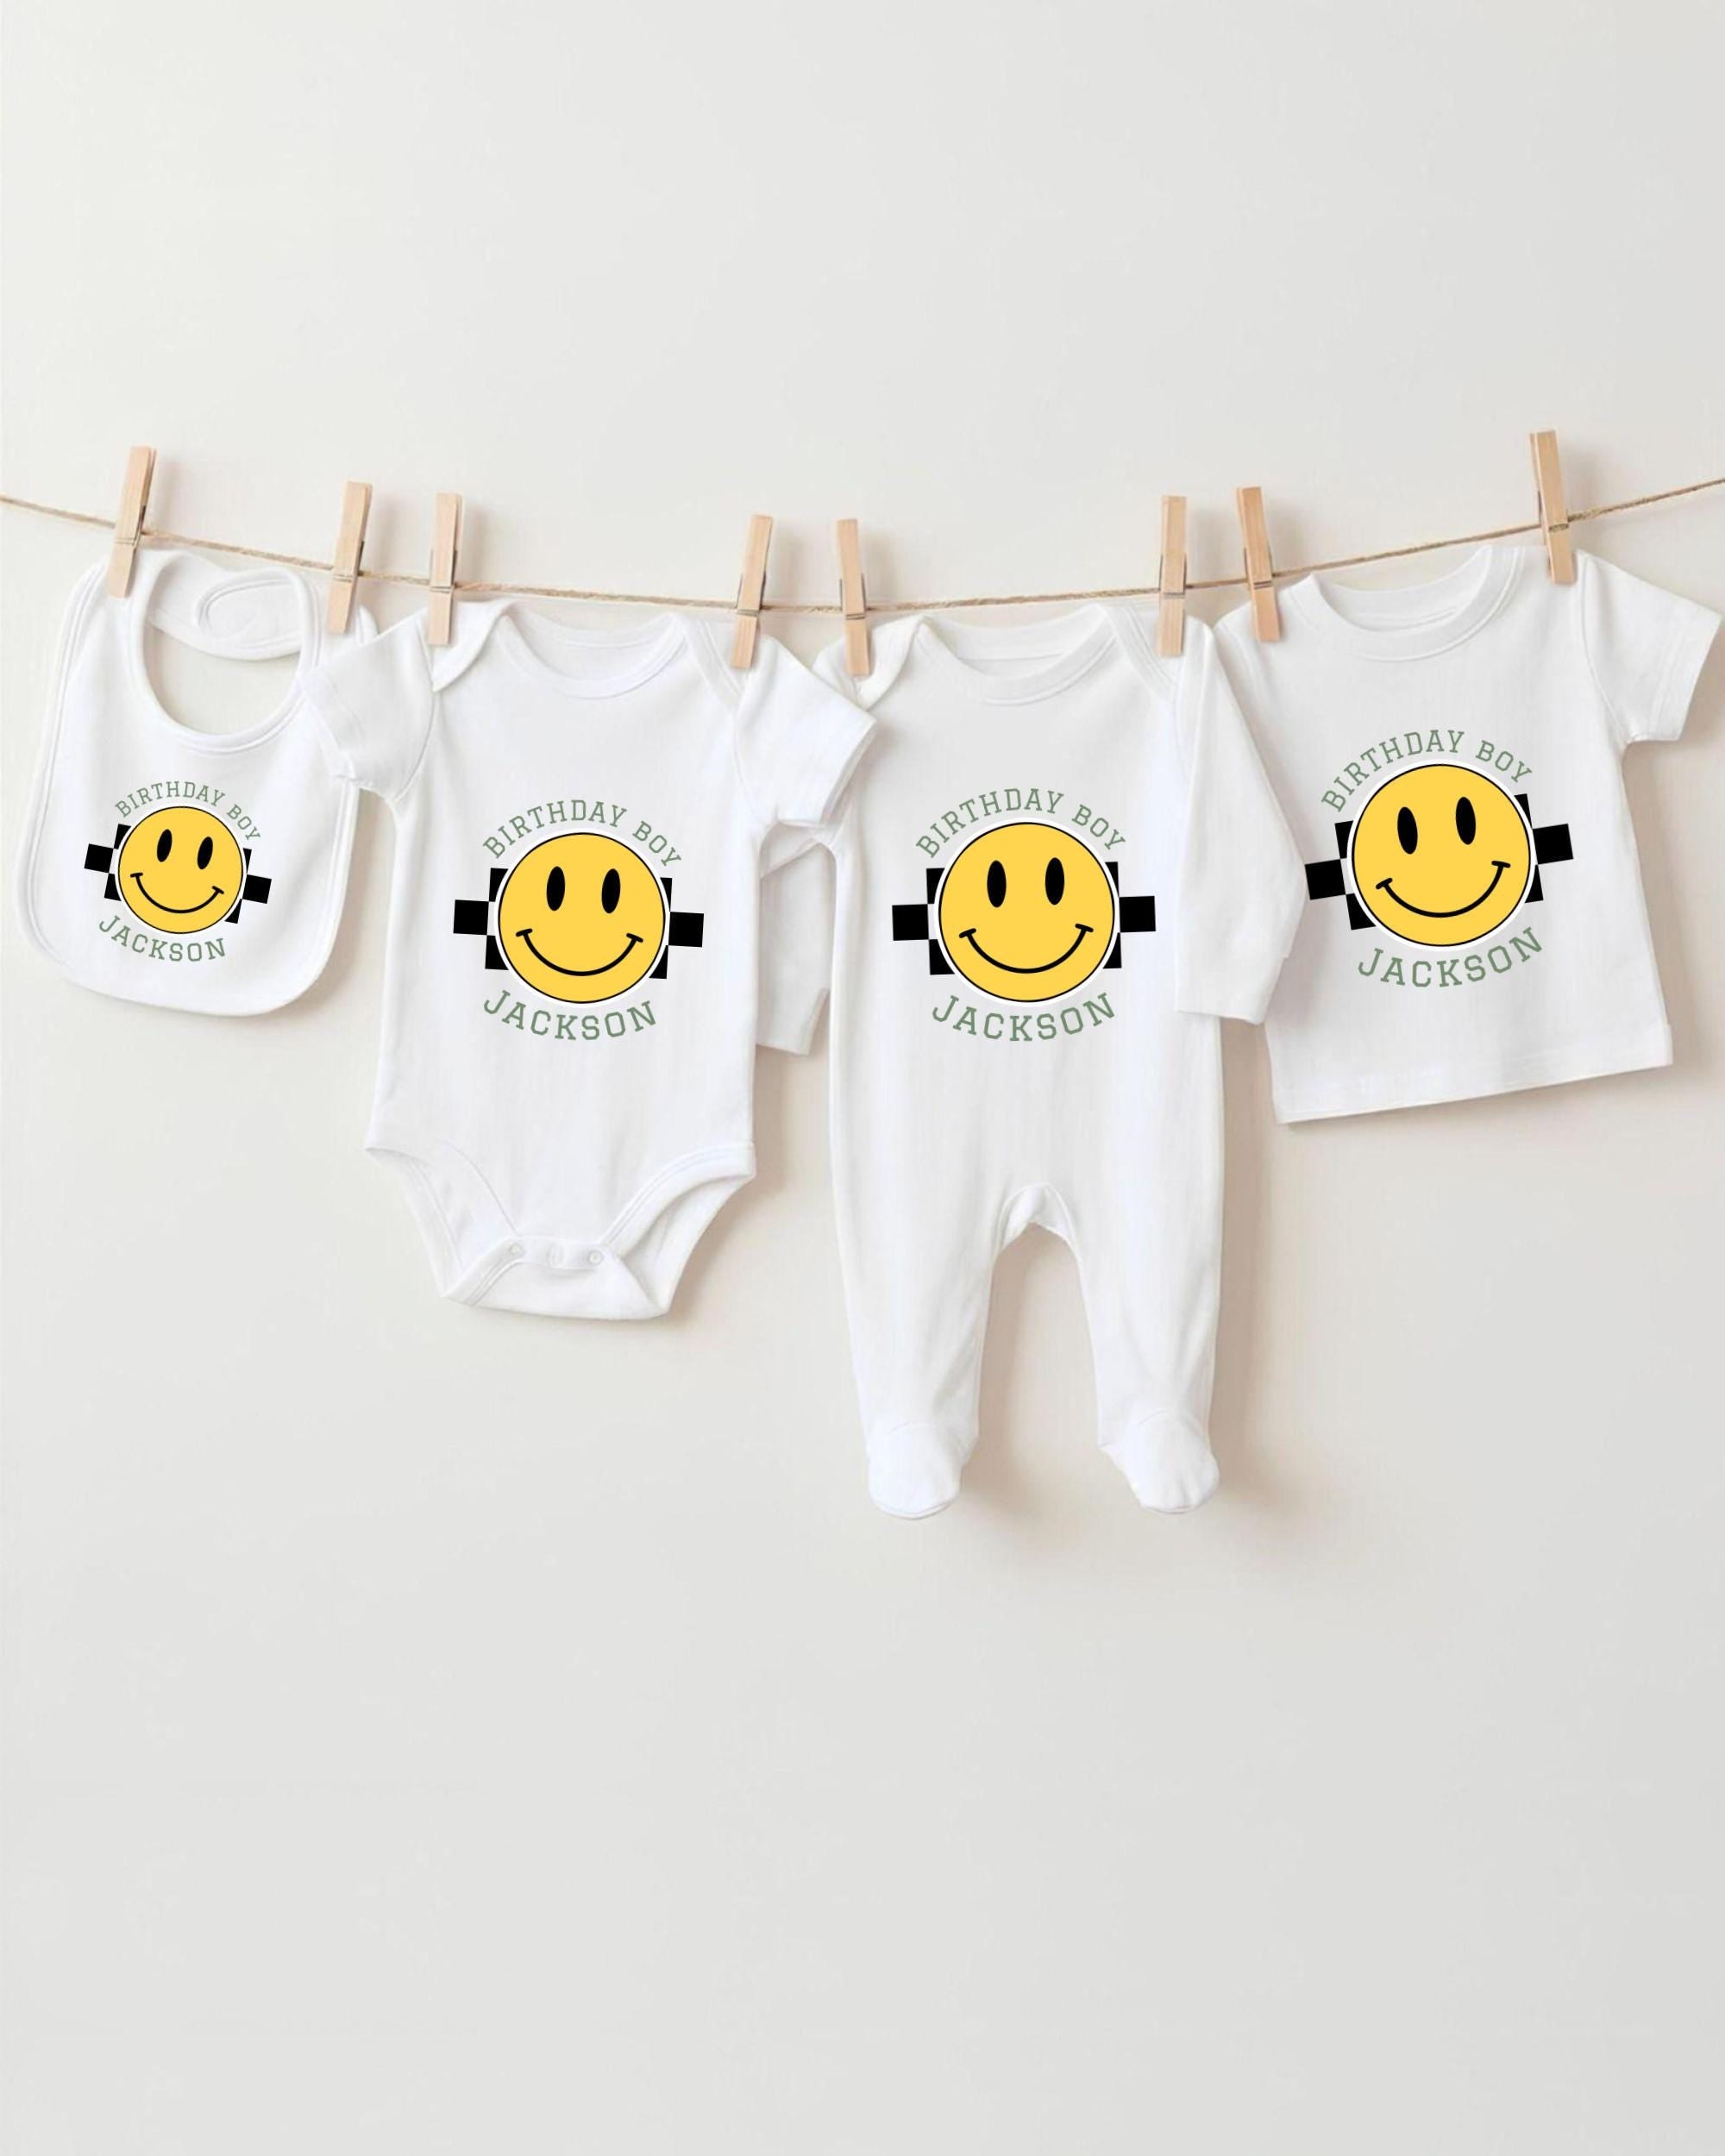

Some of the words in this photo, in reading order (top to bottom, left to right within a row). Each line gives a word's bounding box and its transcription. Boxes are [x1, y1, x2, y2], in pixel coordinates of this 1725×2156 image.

[1320, 730, 1465, 812] BIRTHDAY
[1476, 740, 1533, 783] BOY
[115, 780, 225, 818] BIRTHDAY
[226, 804, 261, 840] BOY
[483, 799, 628, 859] BIRTHDAY
[632, 820, 682, 867] BOY
[915, 787, 1064, 858] BIRTHDAY
[1071, 804, 1126, 850] BOY
[98, 915, 225, 962] JACKSON
[1358, 927, 1542, 987] JACKSON
[484, 991, 656, 1041] JACKSON
[932, 993, 1114, 1042] JACKSON
